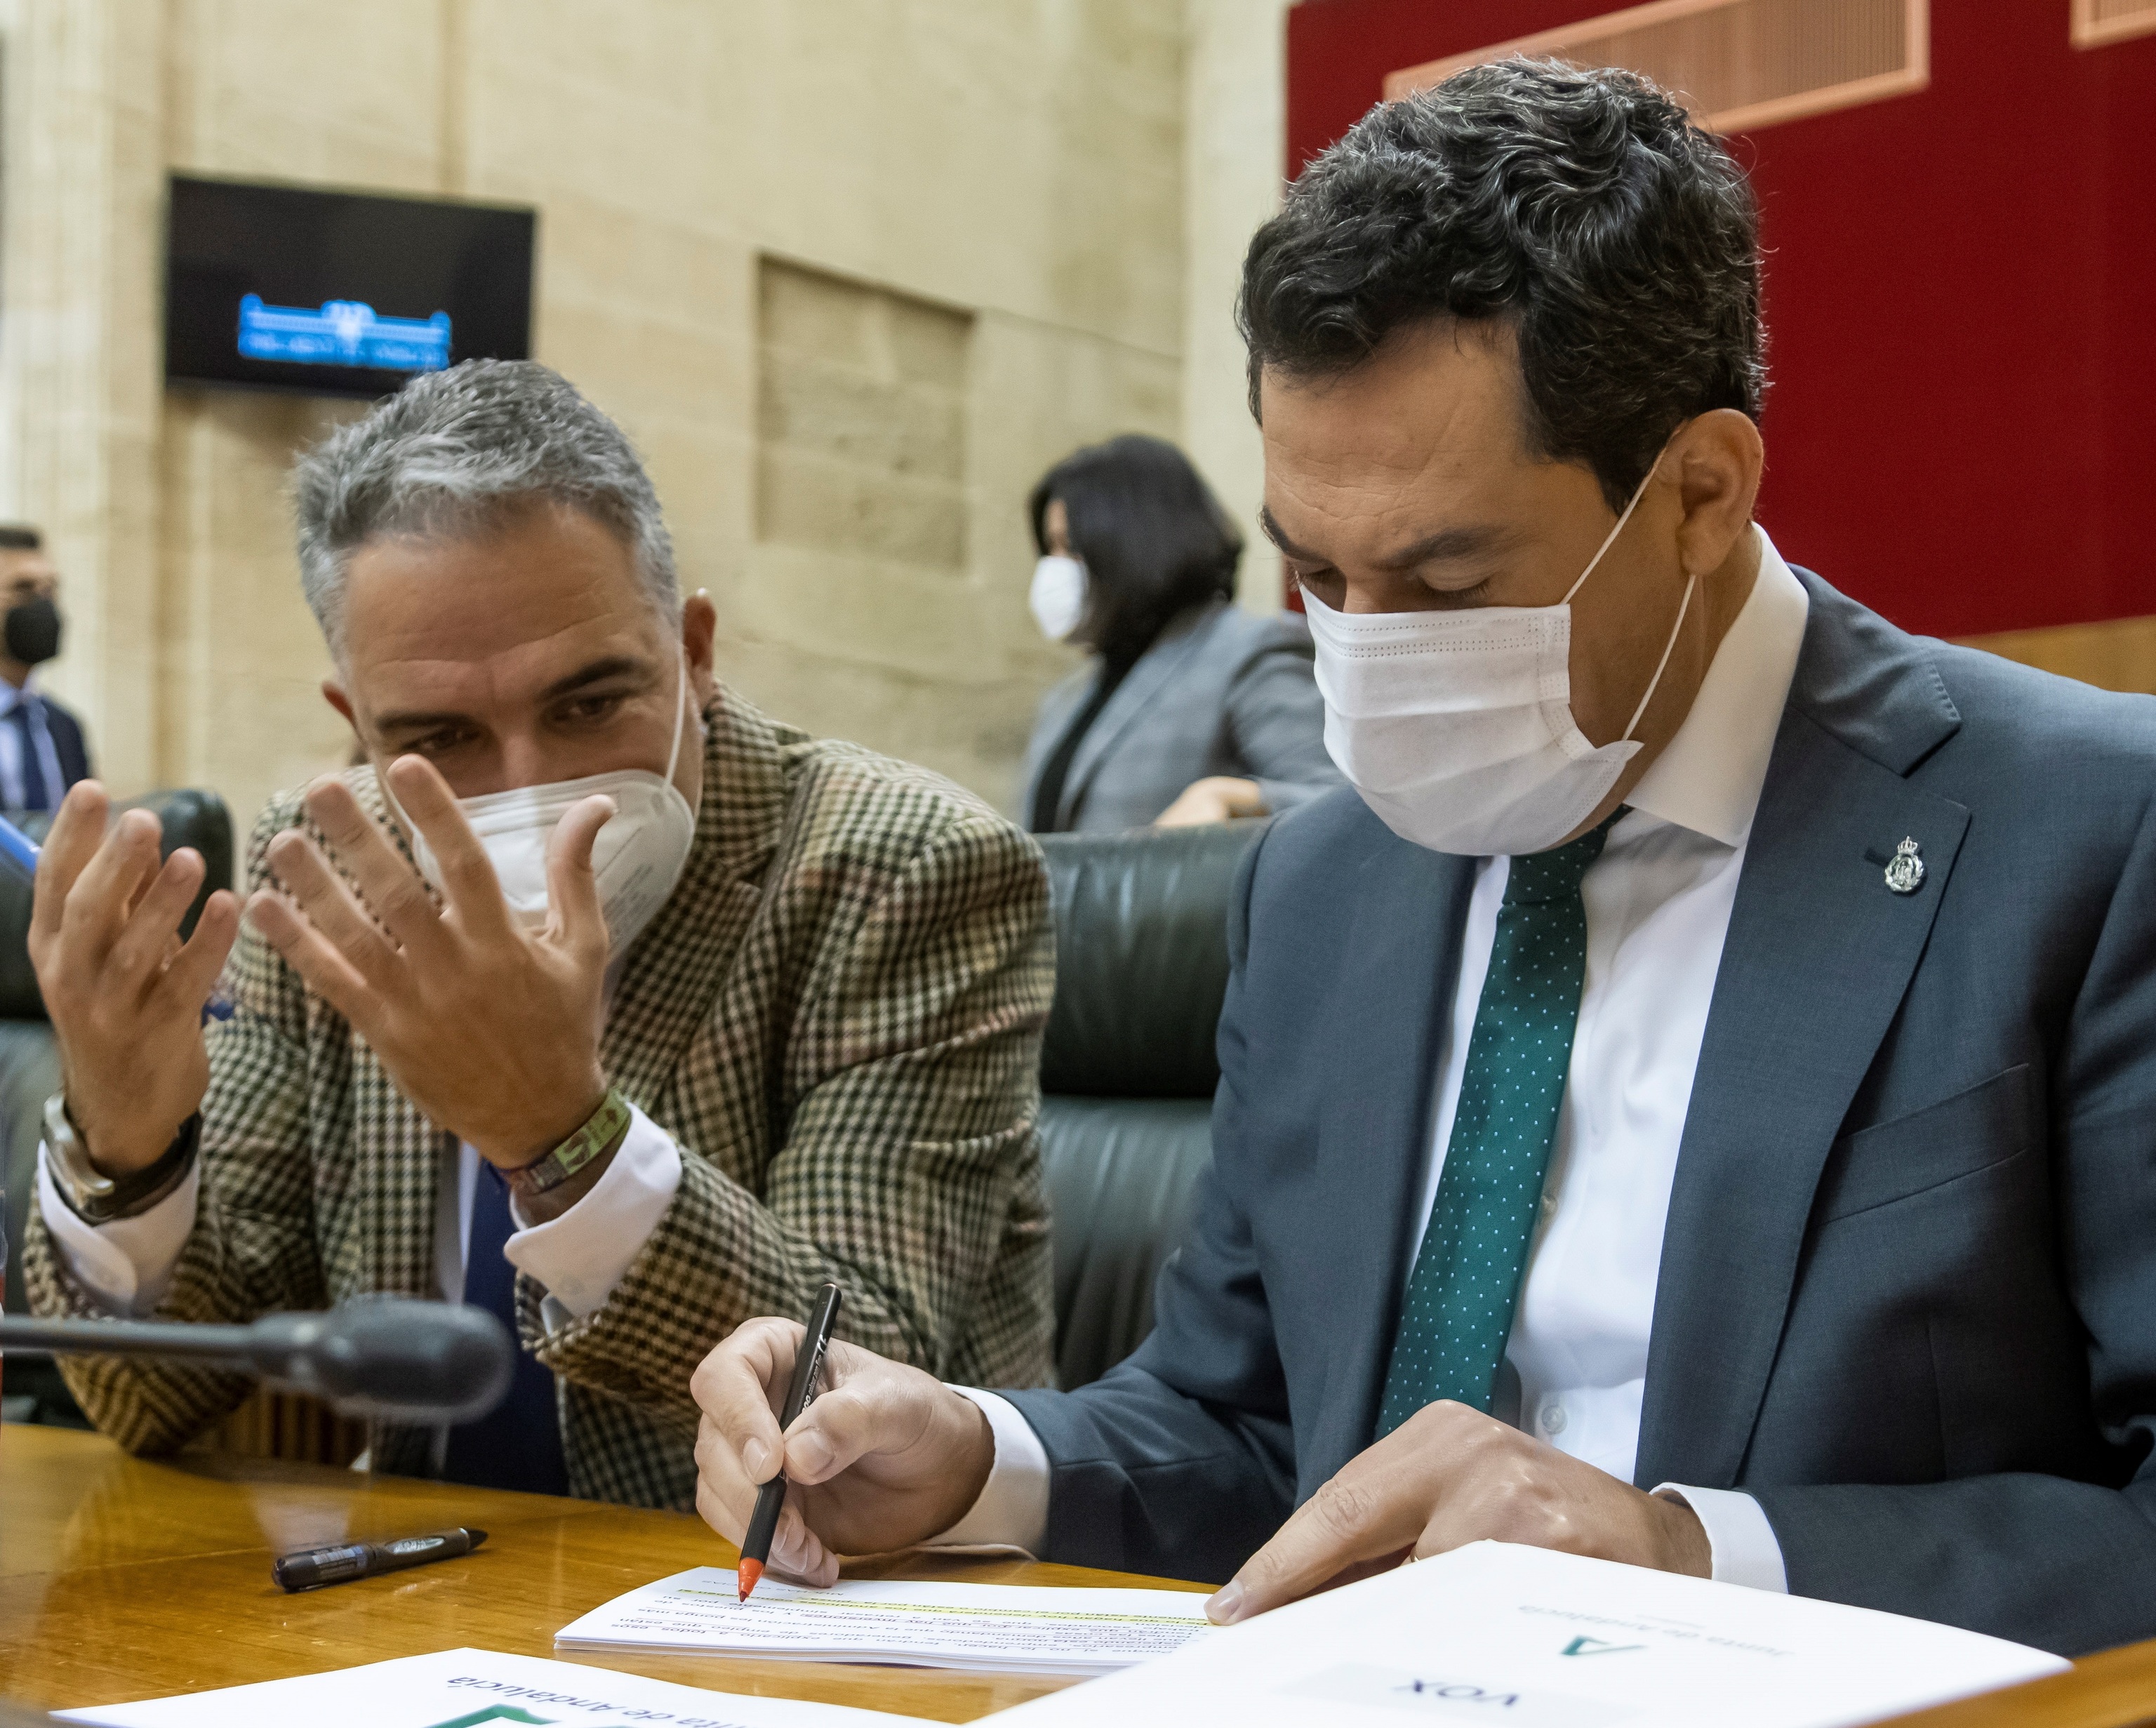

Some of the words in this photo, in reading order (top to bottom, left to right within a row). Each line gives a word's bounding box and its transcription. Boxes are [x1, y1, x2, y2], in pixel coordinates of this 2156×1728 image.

[1662, 1630, 1700, 1638] de
[447, 1677, 627, 1712] Andalucía
[1392, 1679, 1519, 1706] VOX
[622, 1709, 676, 1720] de
